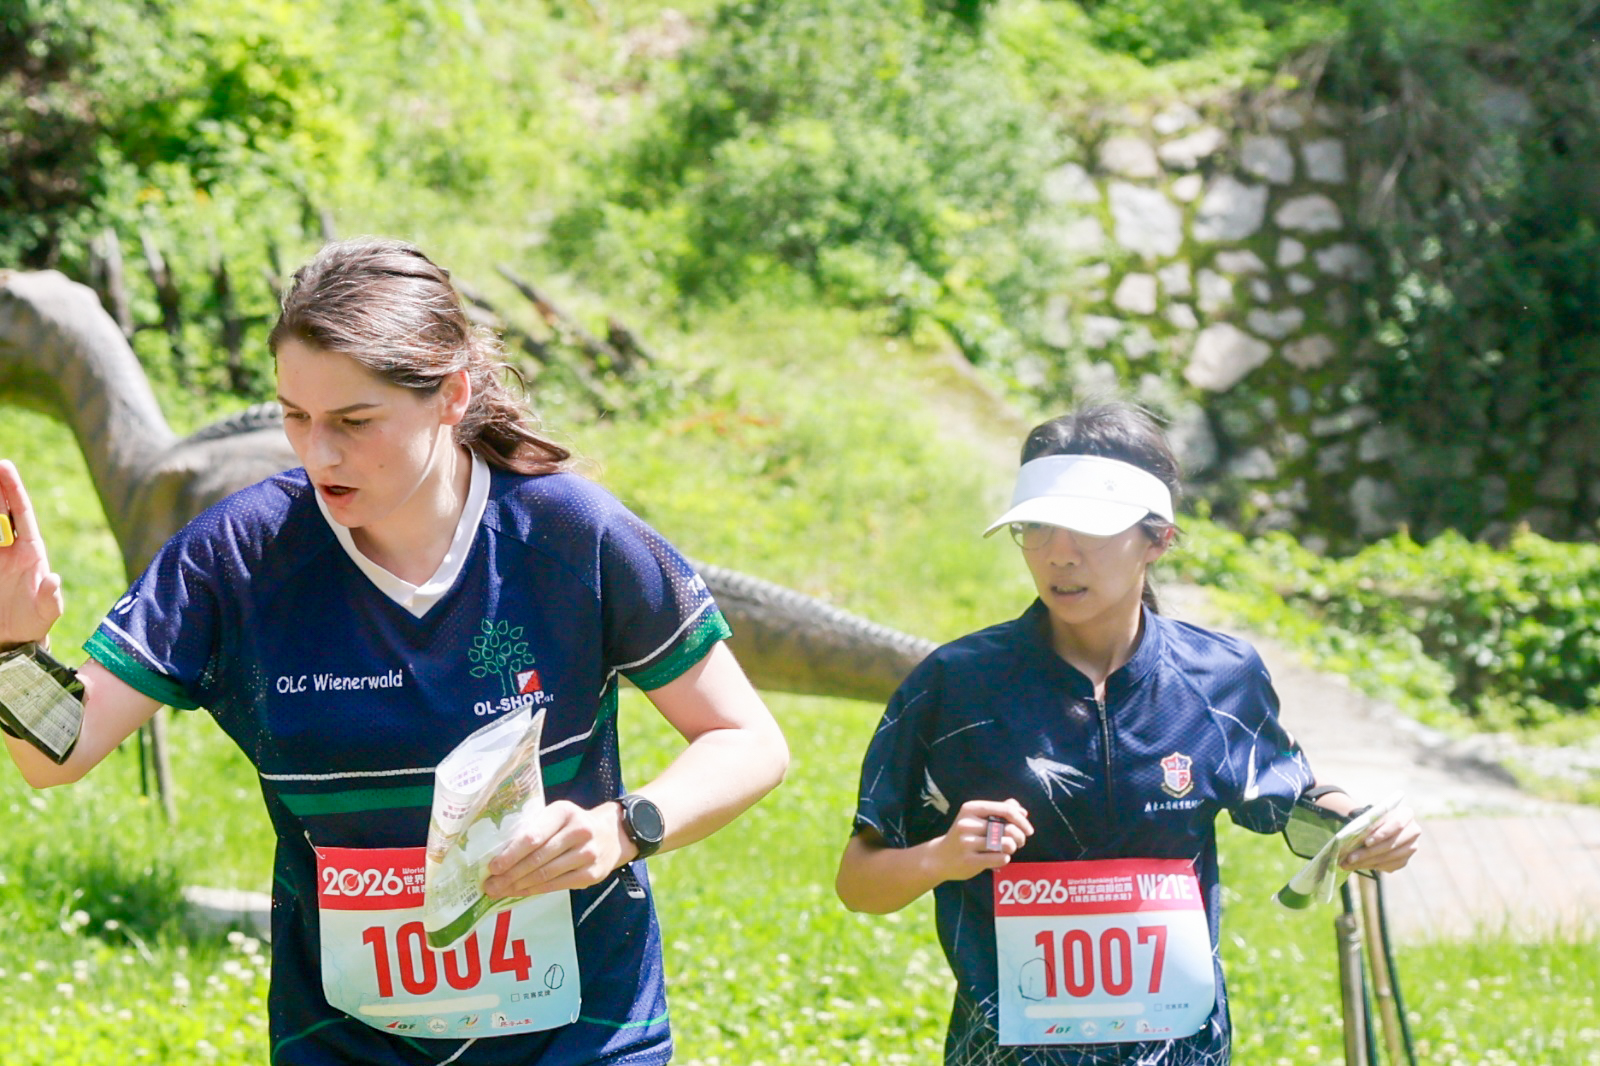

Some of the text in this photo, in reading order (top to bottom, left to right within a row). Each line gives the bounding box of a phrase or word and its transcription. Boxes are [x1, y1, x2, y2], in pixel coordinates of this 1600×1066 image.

[276, 668, 403, 694] OLC Wienerwald
[322, 867, 404, 897] 2026
[999, 879, 1069, 905] 2026
[1136, 874, 1193, 900] W21E
[362, 910, 533, 998] 1004
[1035, 925, 1167, 998] 1007
